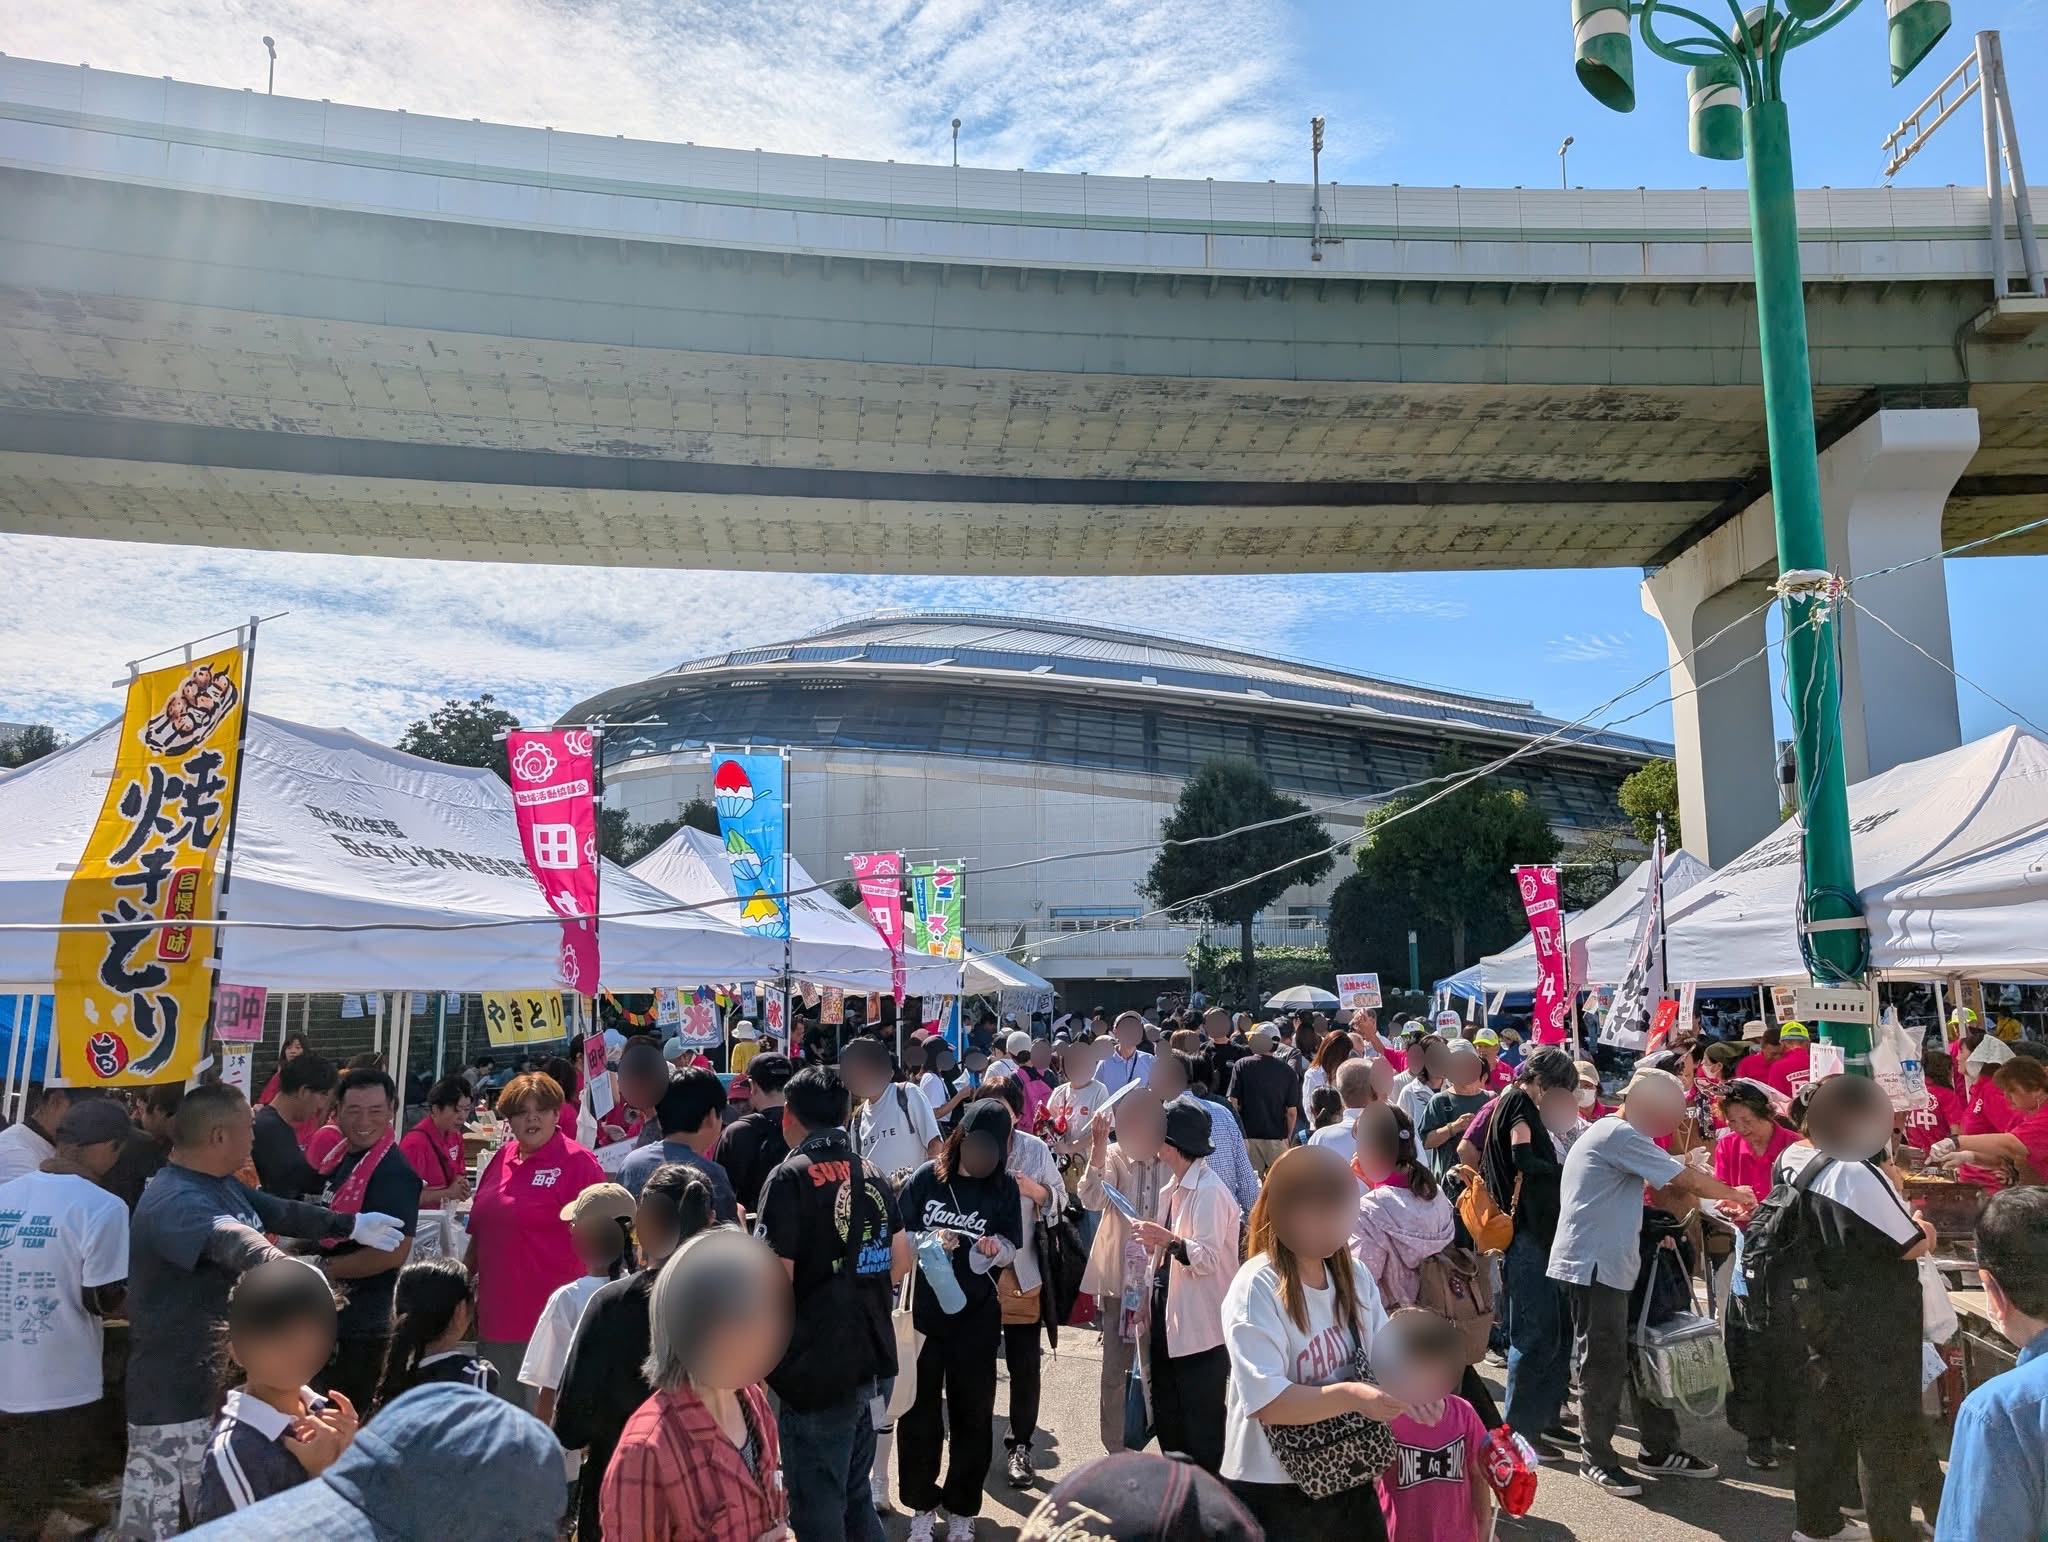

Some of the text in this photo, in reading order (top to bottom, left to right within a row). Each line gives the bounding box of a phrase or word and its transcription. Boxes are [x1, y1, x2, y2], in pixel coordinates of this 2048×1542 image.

[303, 803, 409, 839] 平成28年度
[101, 751, 227, 1074] 焼きとり
[166, 871, 198, 953] 自慢の味
[218, 992, 260, 1030] 田中
[487, 998, 563, 1034] やきとり
[532, 1174, 557, 1188] 田中
[17, 1226, 59, 1238] BASEBALL
[30, 1215, 52, 1225] KICK
[922, 1199, 988, 1234] Tanaka
[22, 1238, 46, 1248] TEAM
[1399, 1449, 1422, 1487] ONE
